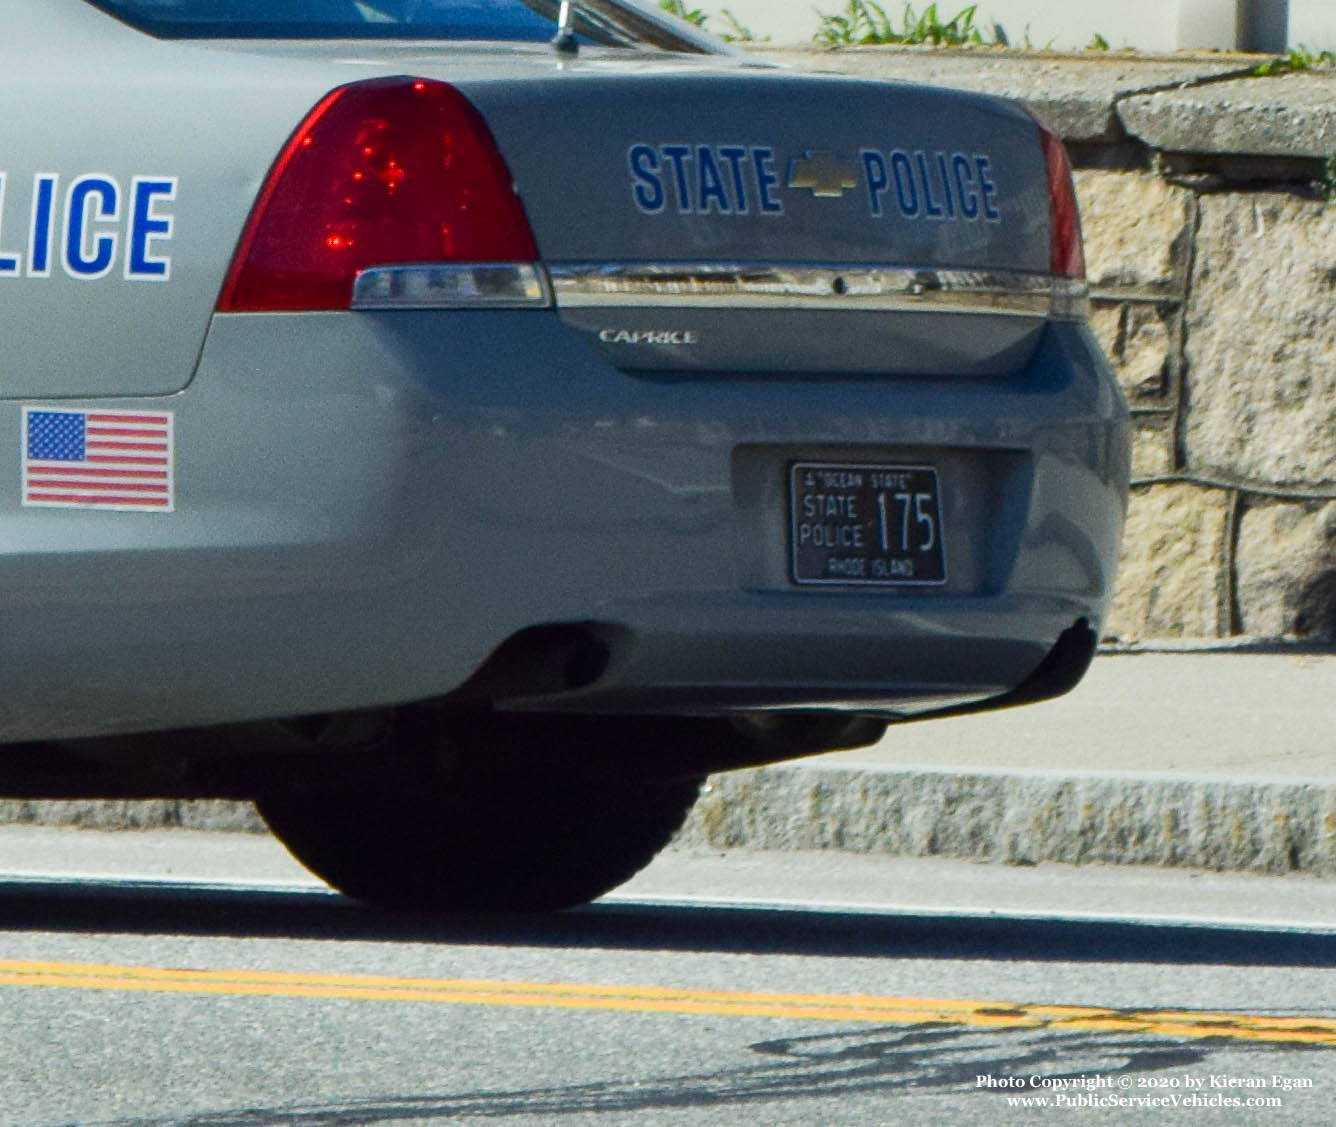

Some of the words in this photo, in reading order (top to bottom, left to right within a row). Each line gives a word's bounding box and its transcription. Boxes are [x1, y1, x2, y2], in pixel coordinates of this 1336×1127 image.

[628, 142, 784, 217] STATE
[859, 148, 1001, 223] POLICE
[598, 328, 698, 345] CAPRICE
[802, 494, 859, 518] STATE
[878, 492, 934, 552] 175
[799, 524, 865, 547] POLICE
[828, 557, 866, 576] RHODE
[871, 557, 915, 577] ISLAND
